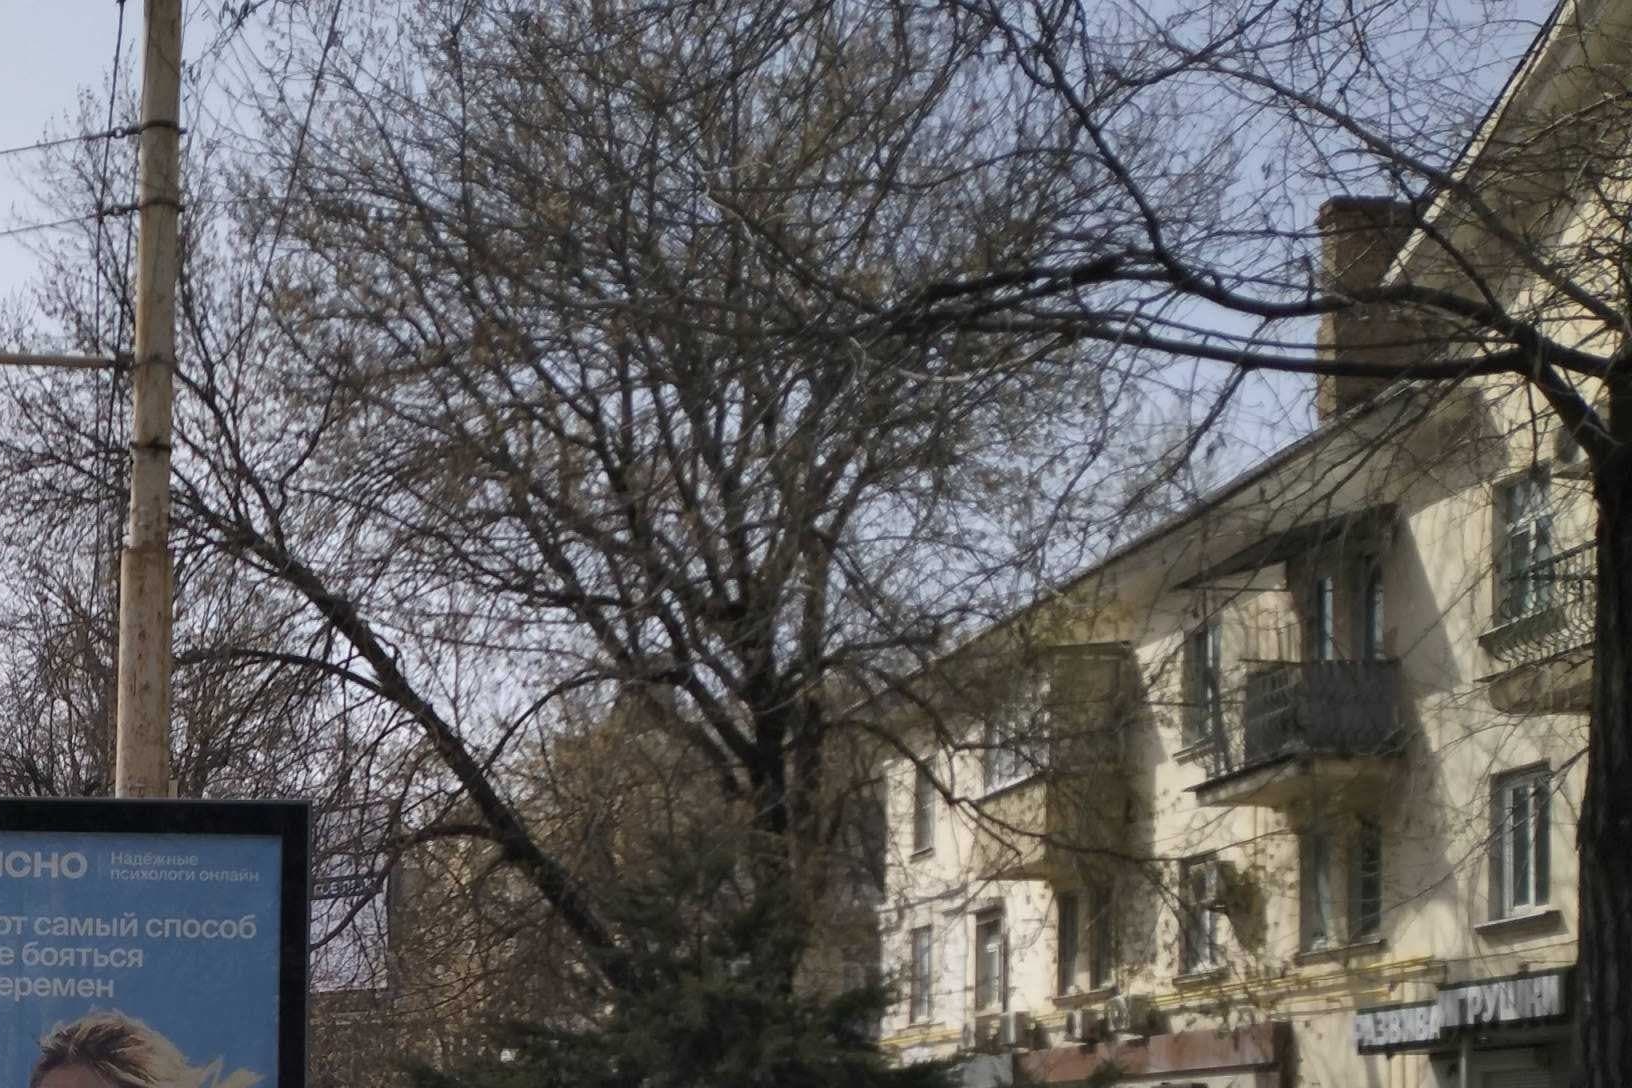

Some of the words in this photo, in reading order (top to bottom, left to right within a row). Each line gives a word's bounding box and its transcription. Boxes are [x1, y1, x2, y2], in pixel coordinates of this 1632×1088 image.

[110, 867, 196, 882] психологи
[199, 868, 259, 883] онлайн
[33, 912, 139, 938] самый
[145, 914, 257, 940] способ
[22, 941, 144, 968] бояться
